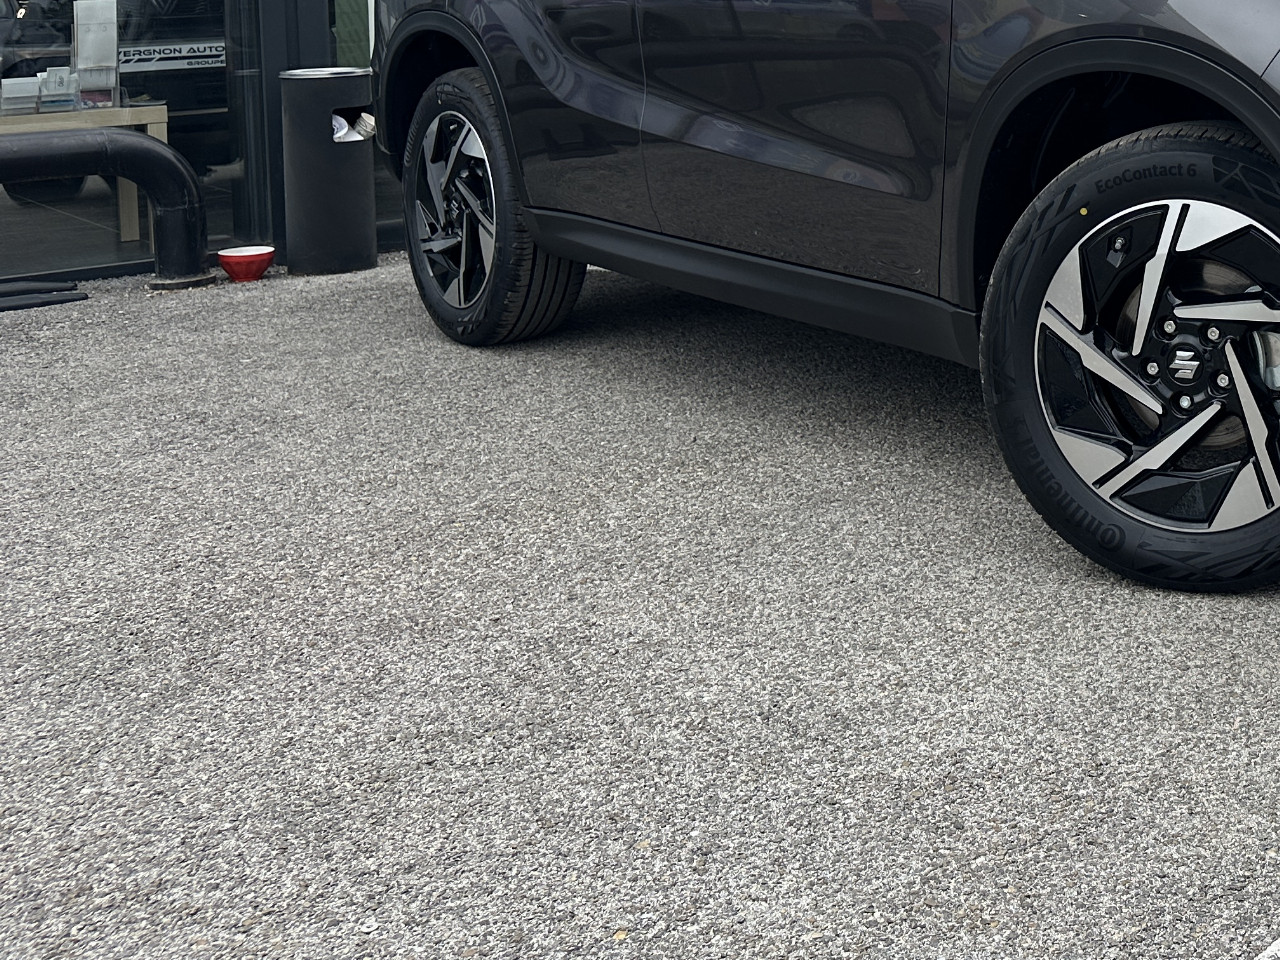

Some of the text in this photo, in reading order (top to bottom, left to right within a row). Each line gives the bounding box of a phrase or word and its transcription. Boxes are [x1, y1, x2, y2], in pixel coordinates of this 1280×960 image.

[186, 45, 225, 54] AUTO
[1094, 163, 1198, 194] EcoContact 6
